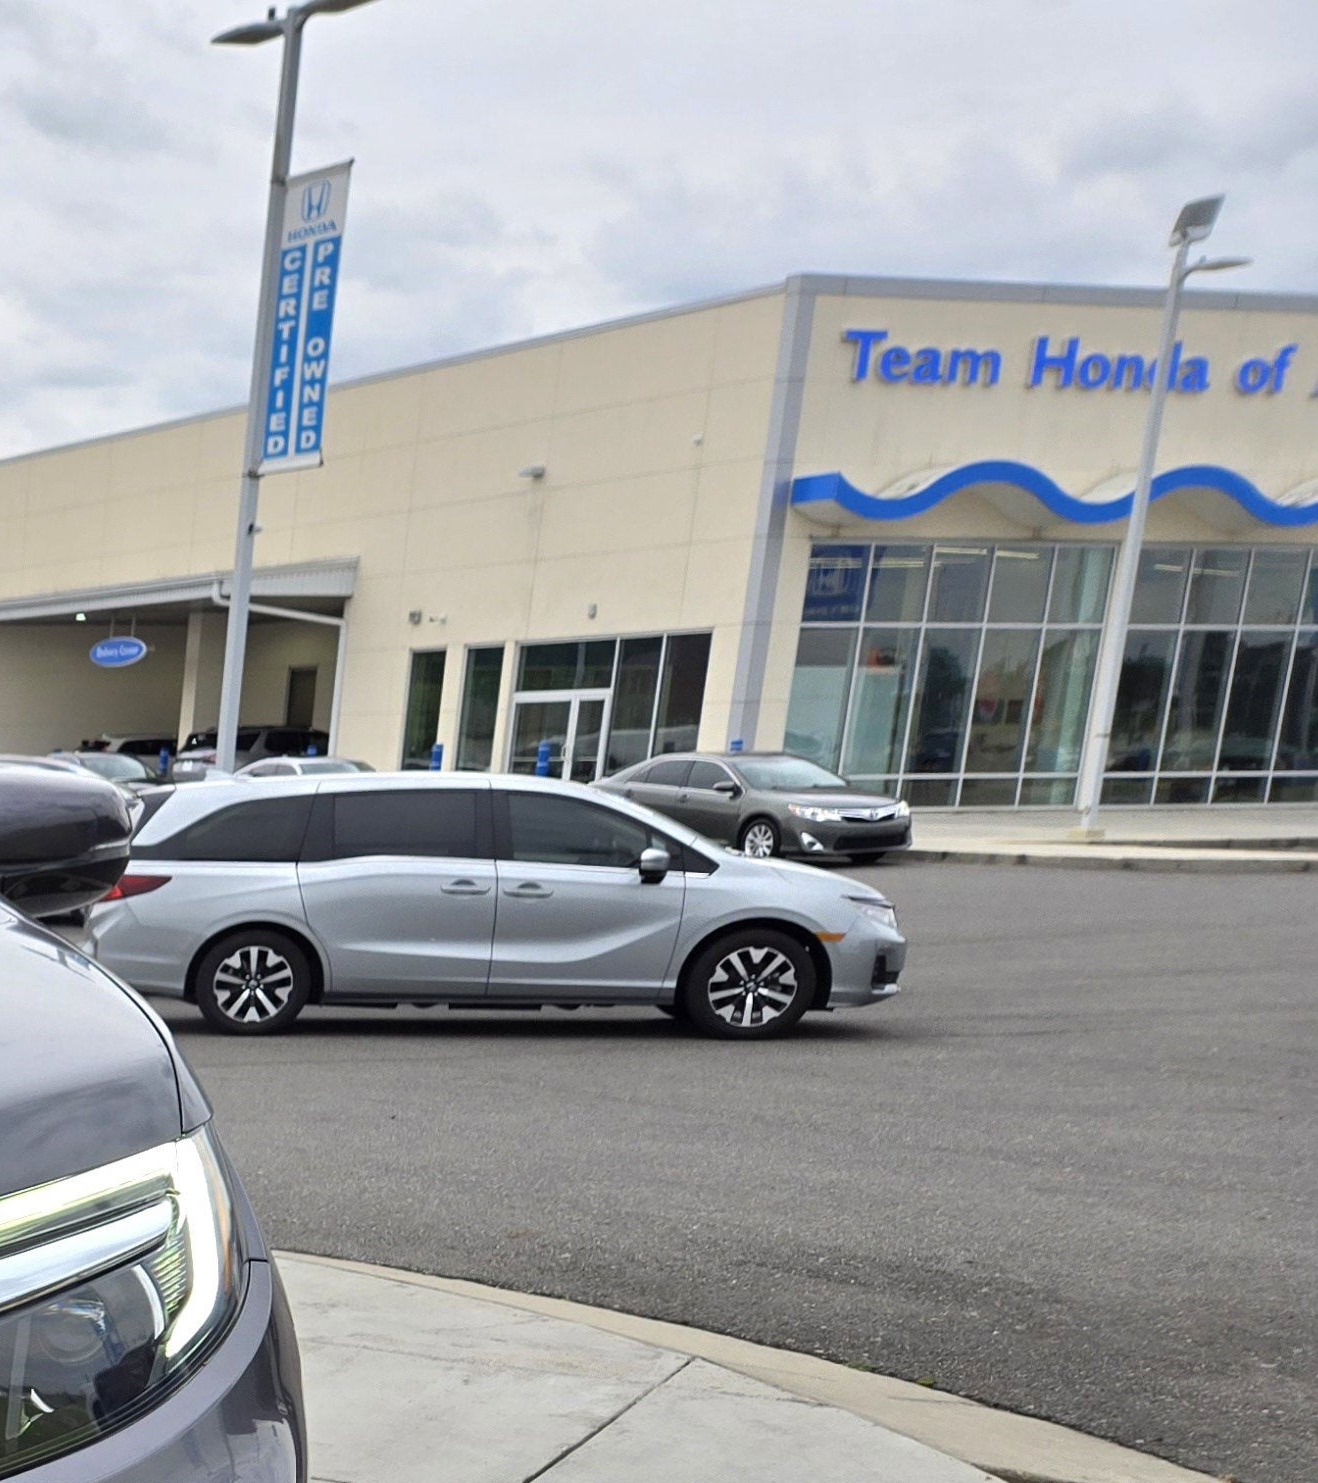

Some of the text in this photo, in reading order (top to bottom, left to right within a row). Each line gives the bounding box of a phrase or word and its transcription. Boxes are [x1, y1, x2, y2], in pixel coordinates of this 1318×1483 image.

[287, 219, 338, 242] HONDA
[266, 249, 301, 455] CERTIFIED
[299, 240, 334, 450] PRE OWNED
[844, 328, 1300, 394] Team Honda of
